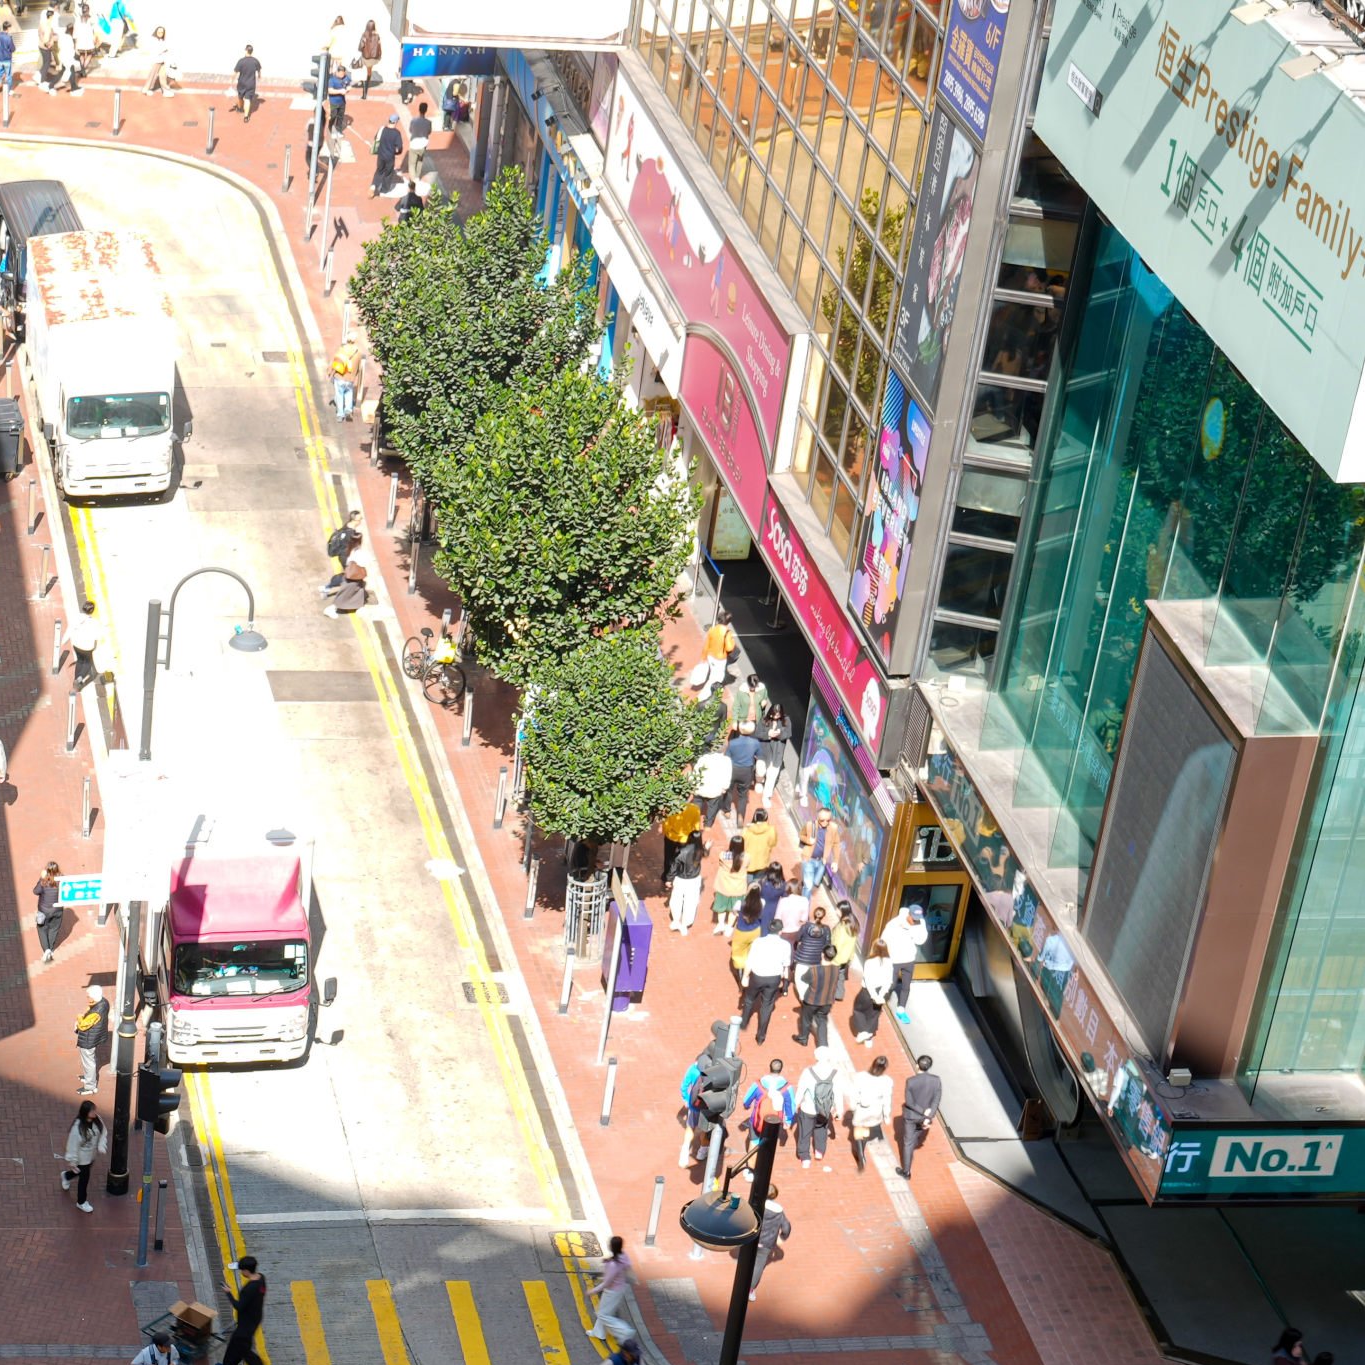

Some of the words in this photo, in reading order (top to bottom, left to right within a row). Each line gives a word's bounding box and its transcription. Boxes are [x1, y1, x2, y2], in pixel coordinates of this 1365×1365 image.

[413, 47, 486, 57] HANNAH
[985, 21, 1001, 50] 6/F
[741, 303, 759, 343] Leisure
[758, 329, 775, 376] Dining
[745, 345, 769, 399] Shopping
[872, 488, 909, 548] BEVERLEY
[881, 471, 908, 520] ISLAND
[790, 552, 809, 598] 莎莎
